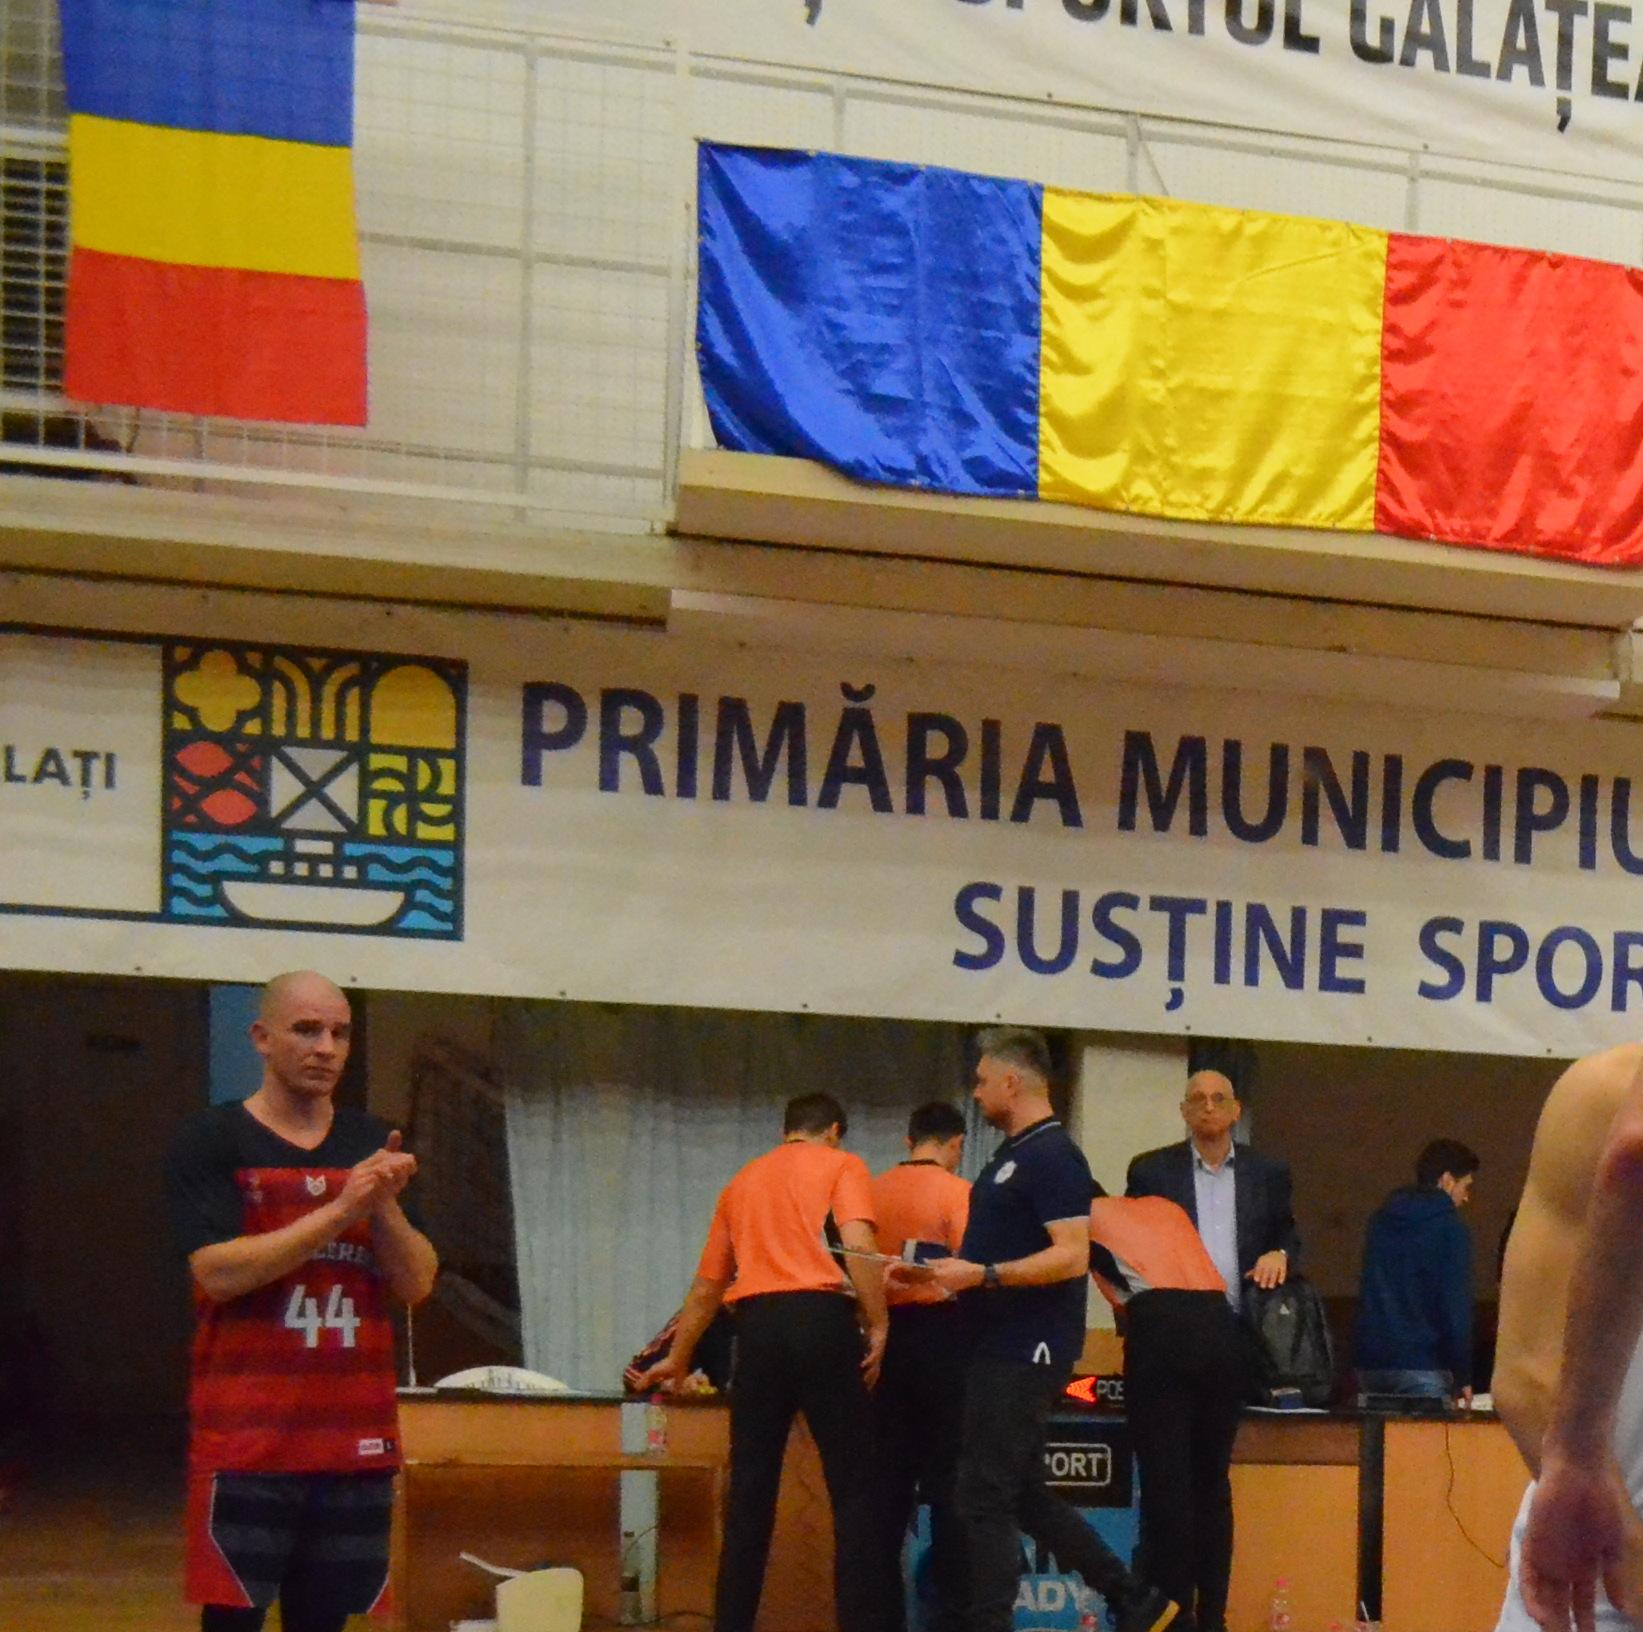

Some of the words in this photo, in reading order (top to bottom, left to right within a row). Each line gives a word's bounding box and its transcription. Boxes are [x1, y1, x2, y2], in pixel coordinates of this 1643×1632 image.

[520, 680, 1084, 830] PRIMĂRIA
[952, 881, 1368, 1012] SUSȚINE
[284, 1284, 361, 1348] 44
[1045, 1452, 1104, 1477] ORT
